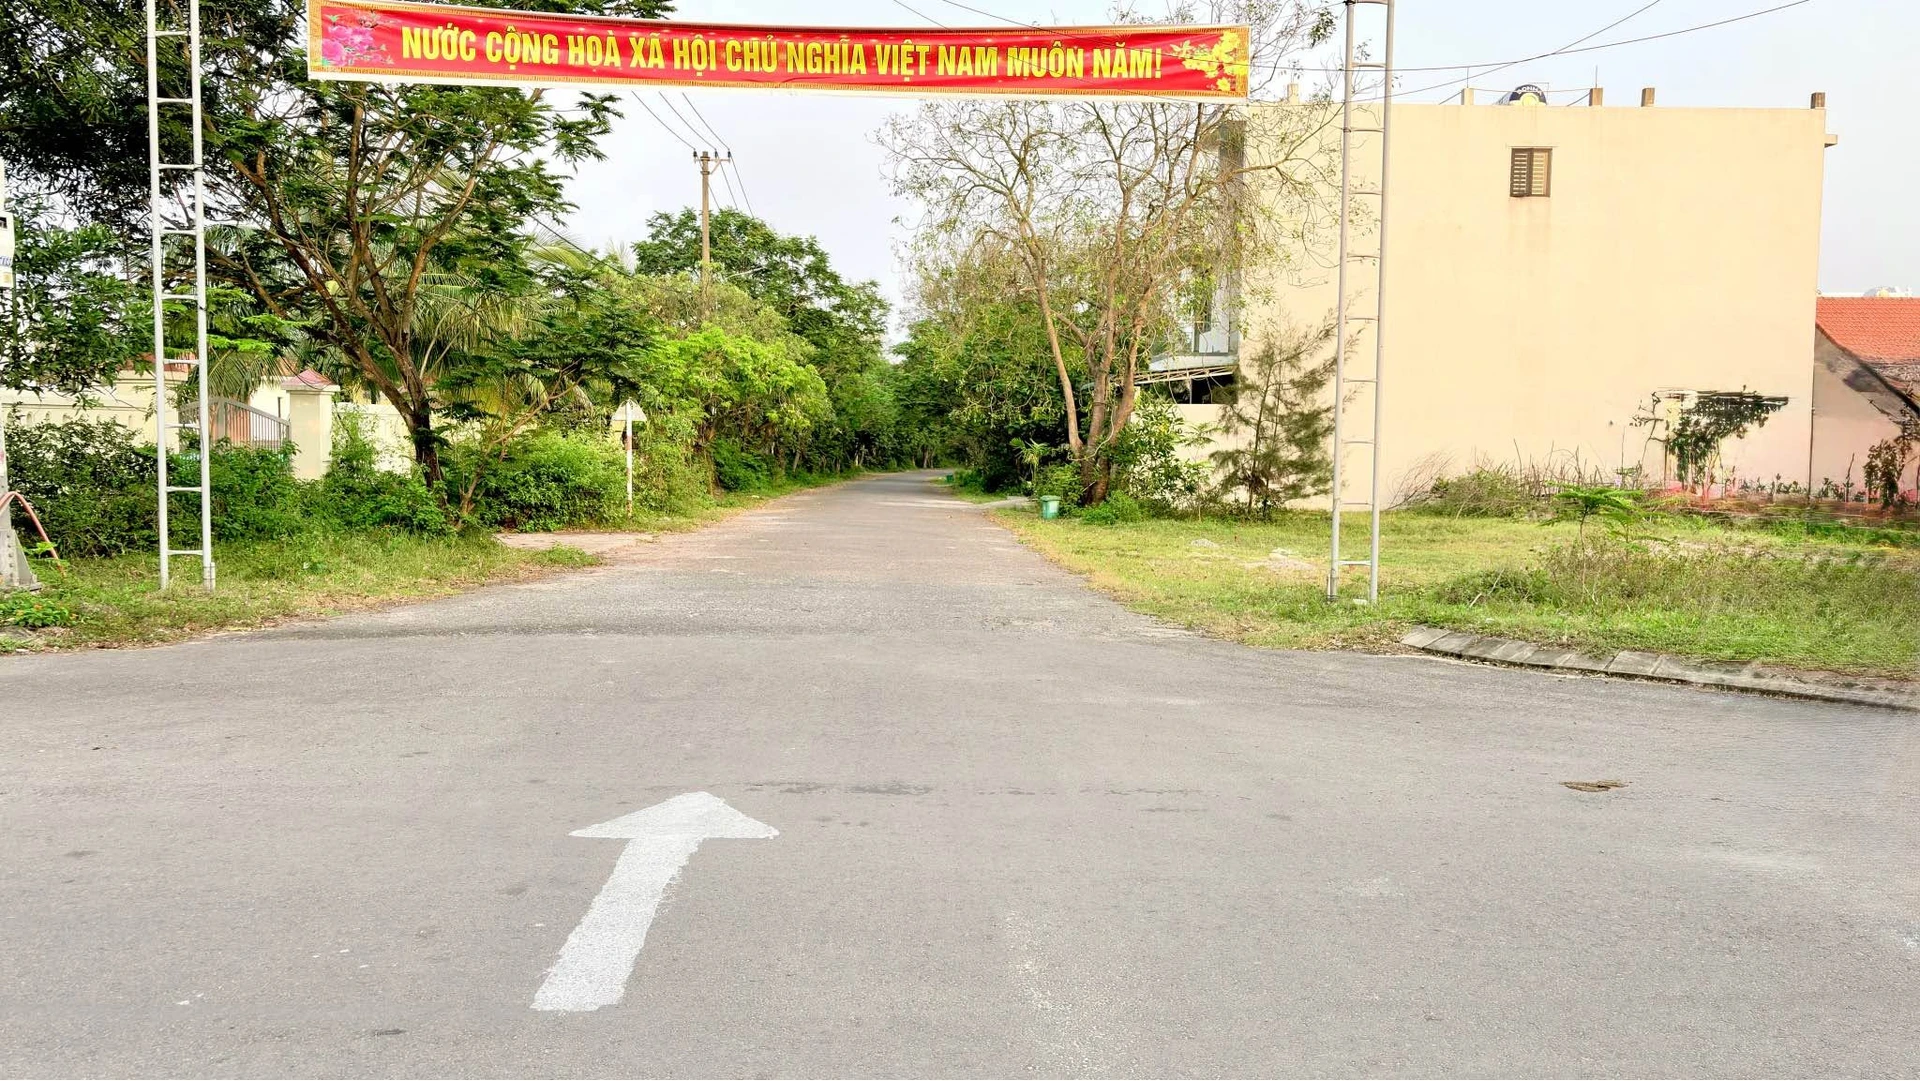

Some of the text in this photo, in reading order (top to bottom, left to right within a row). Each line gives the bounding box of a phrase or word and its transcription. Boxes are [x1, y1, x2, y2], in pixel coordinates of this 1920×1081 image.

[402, 22, 1163, 82] NƯỚC CỘNG HOÀ XÃ HỘI CHỦ NGHĨA VIỆT NAM MUÔN NĂM!
